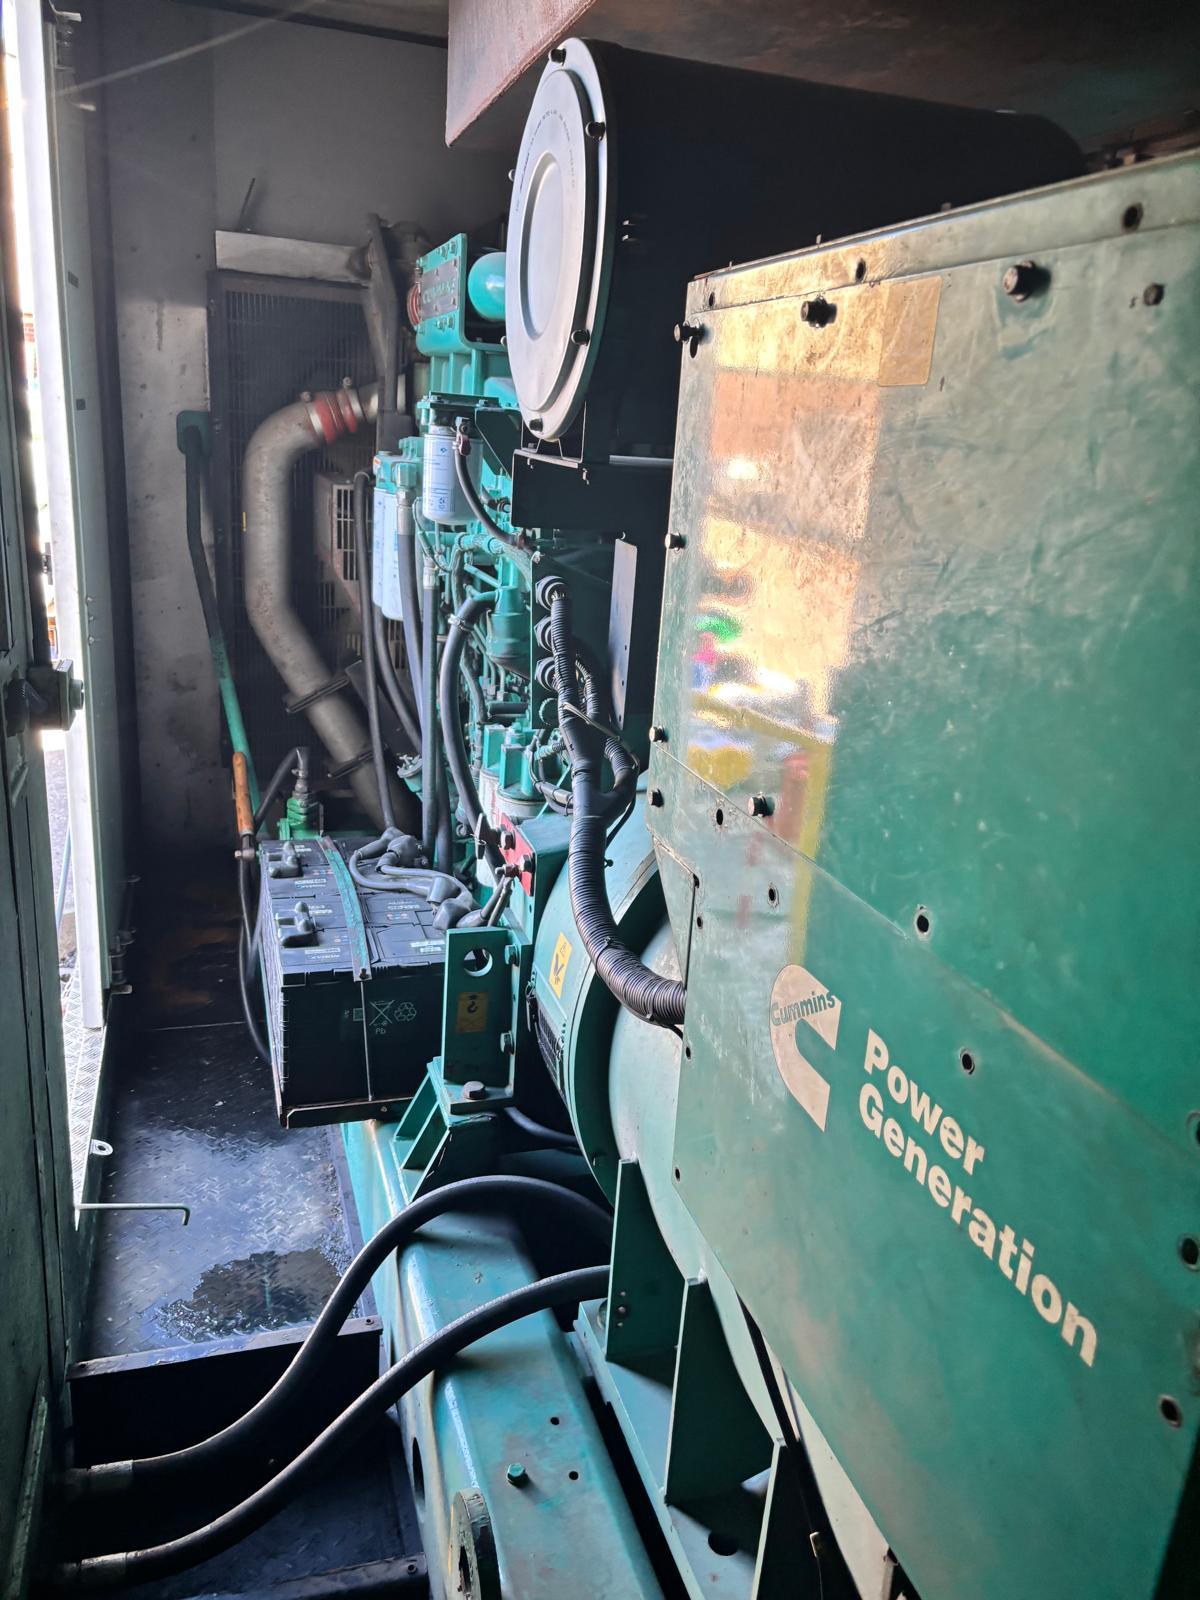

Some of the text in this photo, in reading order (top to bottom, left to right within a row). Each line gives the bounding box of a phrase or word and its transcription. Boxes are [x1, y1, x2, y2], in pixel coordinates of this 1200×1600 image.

[771, 991, 837, 1026] Cummins
[864, 1029, 985, 1175] Power
[860, 1083, 1097, 1367] Generation
